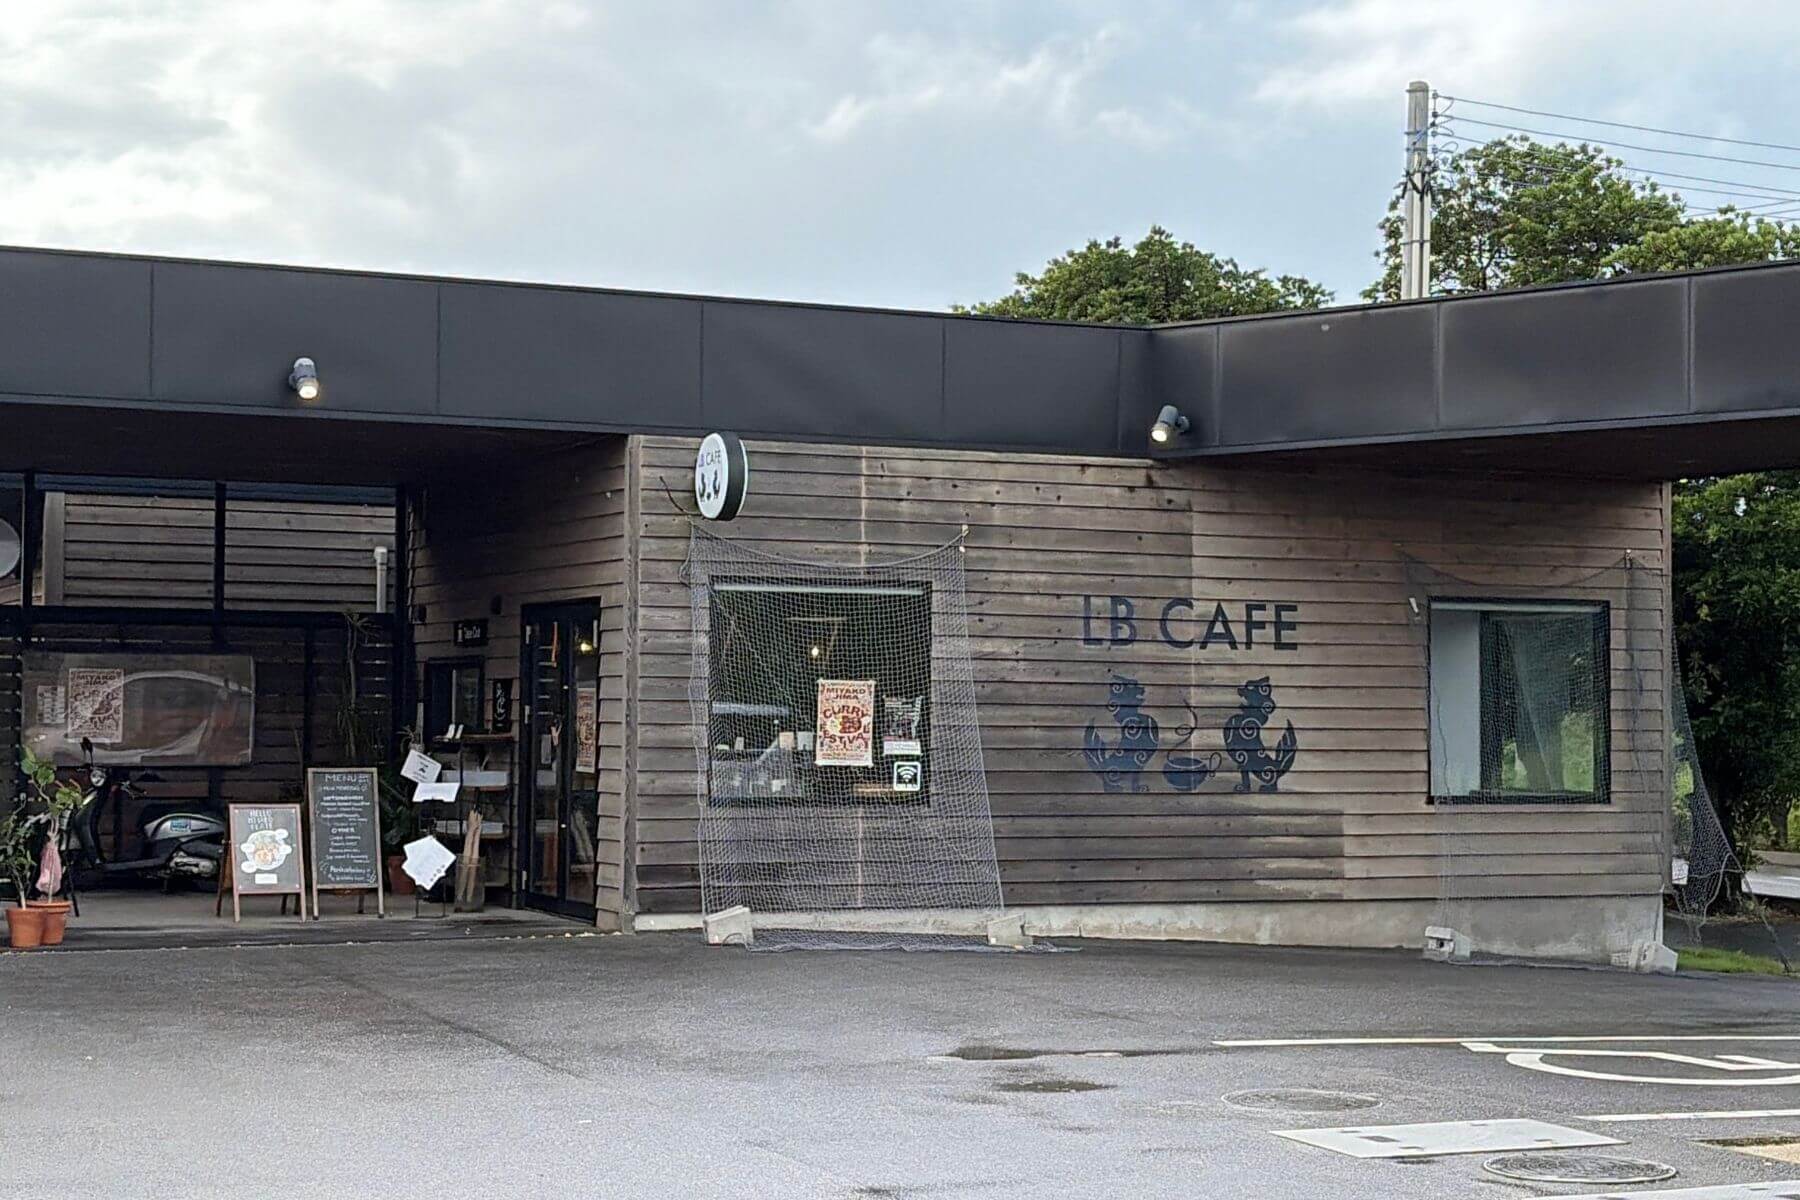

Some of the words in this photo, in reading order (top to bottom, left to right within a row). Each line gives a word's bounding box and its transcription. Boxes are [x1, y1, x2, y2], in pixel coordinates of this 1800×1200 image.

[1082, 595, 1138, 647] LB
[1159, 597, 1298, 650] CAFE
[826, 687, 866, 695] MIYAKO
[823, 705, 870, 719] CURRY
[325, 774, 357, 782] MENU
